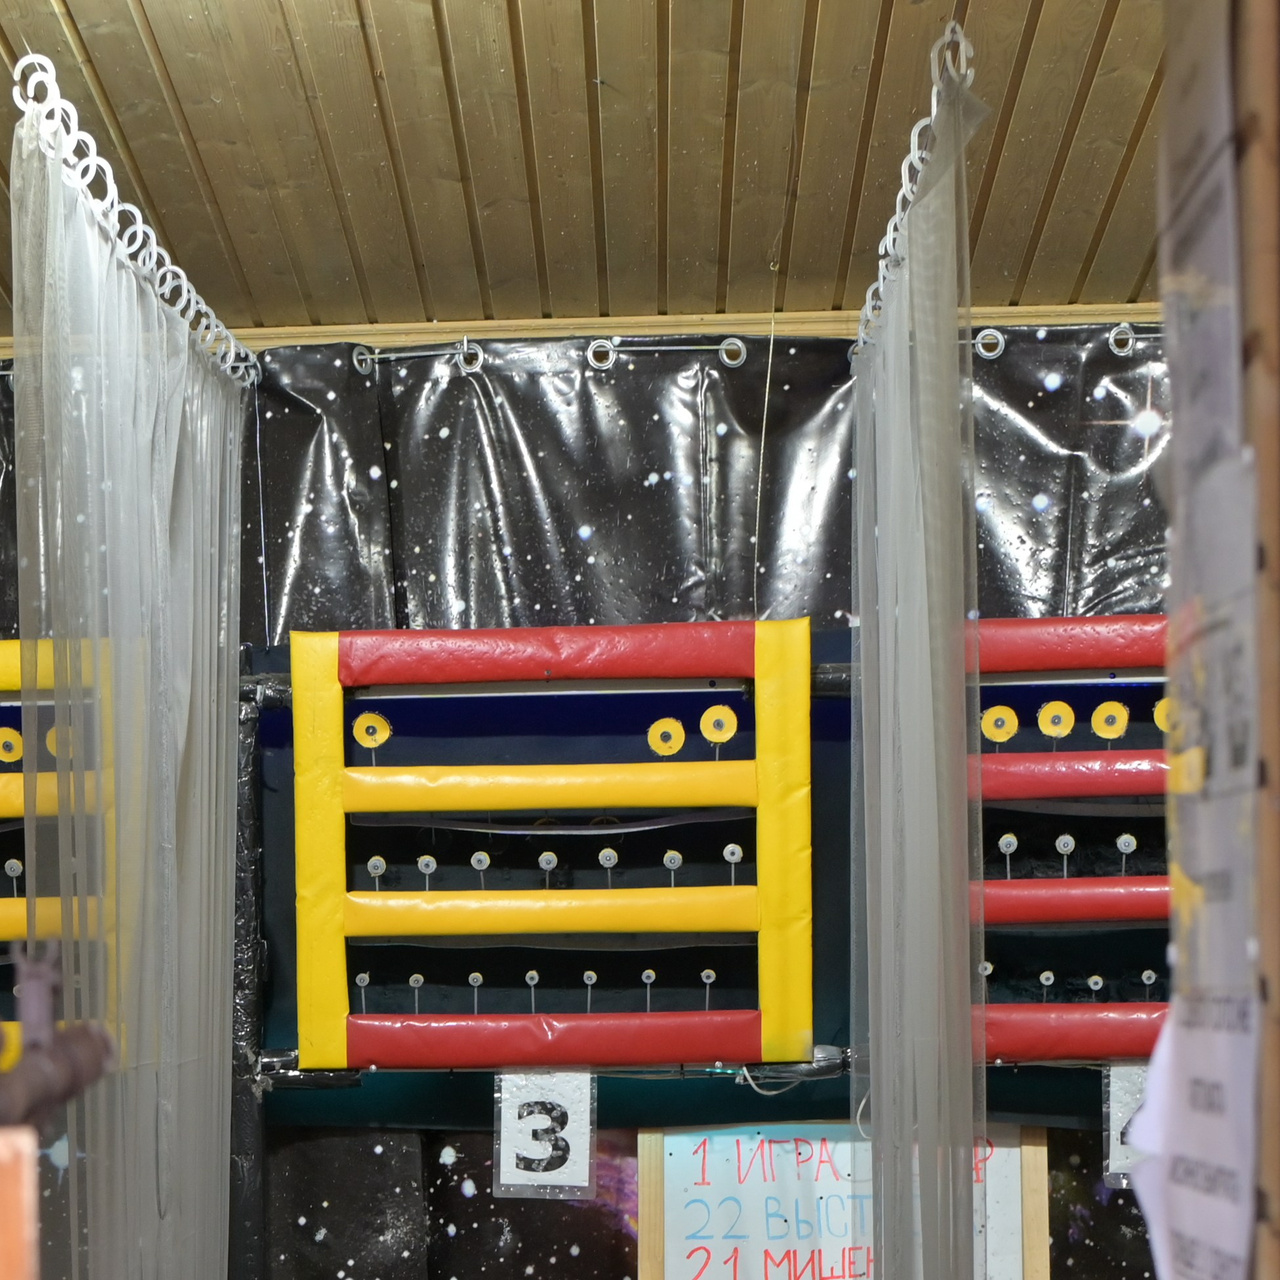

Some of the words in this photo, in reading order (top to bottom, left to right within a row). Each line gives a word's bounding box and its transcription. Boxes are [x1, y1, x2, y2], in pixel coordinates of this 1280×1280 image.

[515, 1101, 571, 1173] 3
[692, 1138, 711, 1186] 1
[735, 1137, 840, 1185] ИГРА
[684, 1196, 750, 1241] 22
[765, 1195, 874, 1241] ВЫСТ
